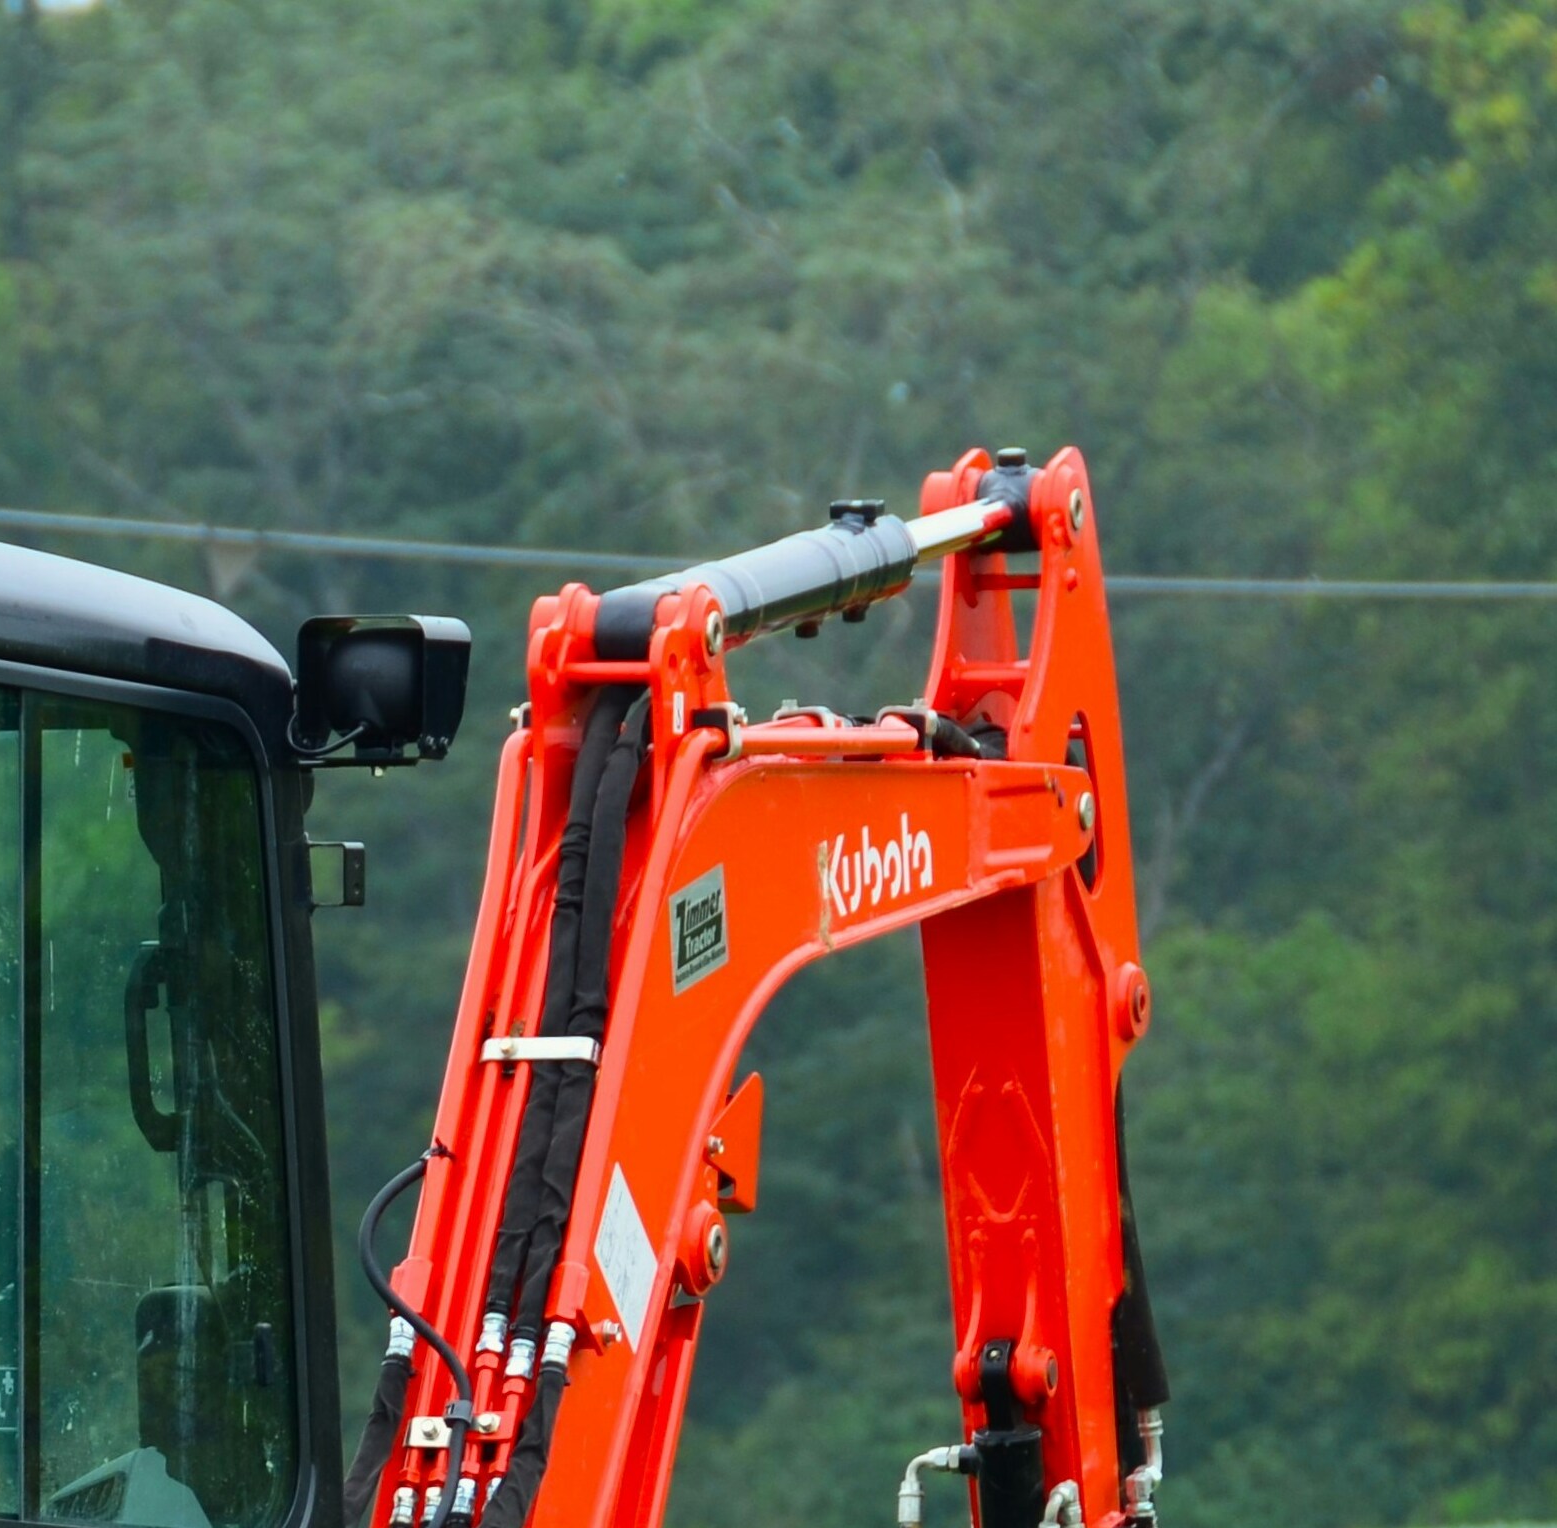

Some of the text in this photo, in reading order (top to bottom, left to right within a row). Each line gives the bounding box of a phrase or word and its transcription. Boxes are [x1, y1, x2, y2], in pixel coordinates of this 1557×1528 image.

[817, 812, 933, 917] Kubota
[676, 888, 722, 969] Zimmer
[685, 924, 717, 960] Tractor
